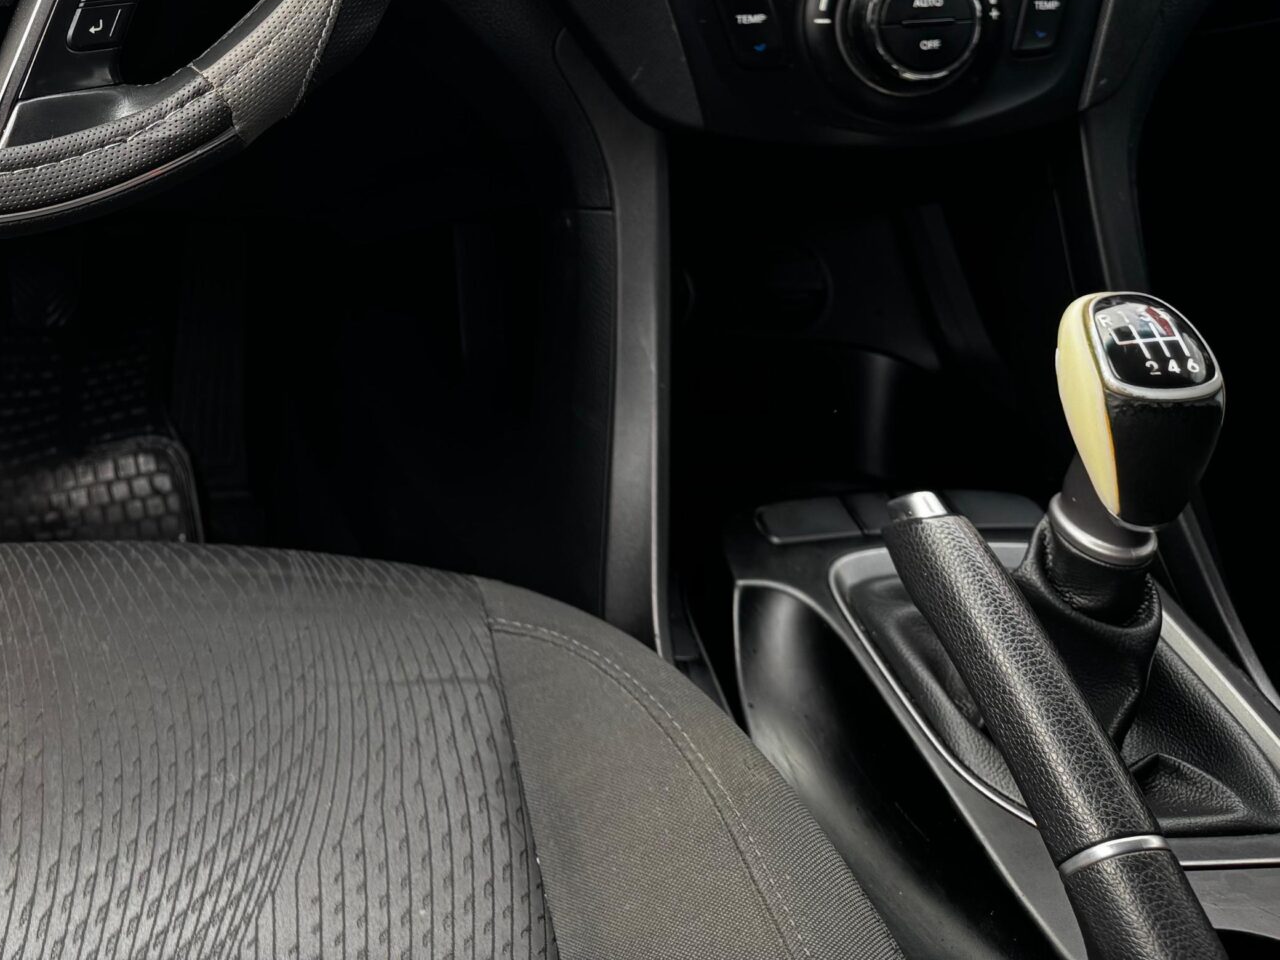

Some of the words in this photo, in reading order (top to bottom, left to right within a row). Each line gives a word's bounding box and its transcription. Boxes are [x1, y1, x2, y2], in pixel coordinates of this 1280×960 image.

[1034, 0, 1061, 11] TEMP
[736, 13, 767, 24] TEMP
[919, 39, 942, 52] OFF
[1145, 360, 1162, 376] 2
[1168, 359, 1180, 373] 4
[1187, 359, 1200, 372] 6
